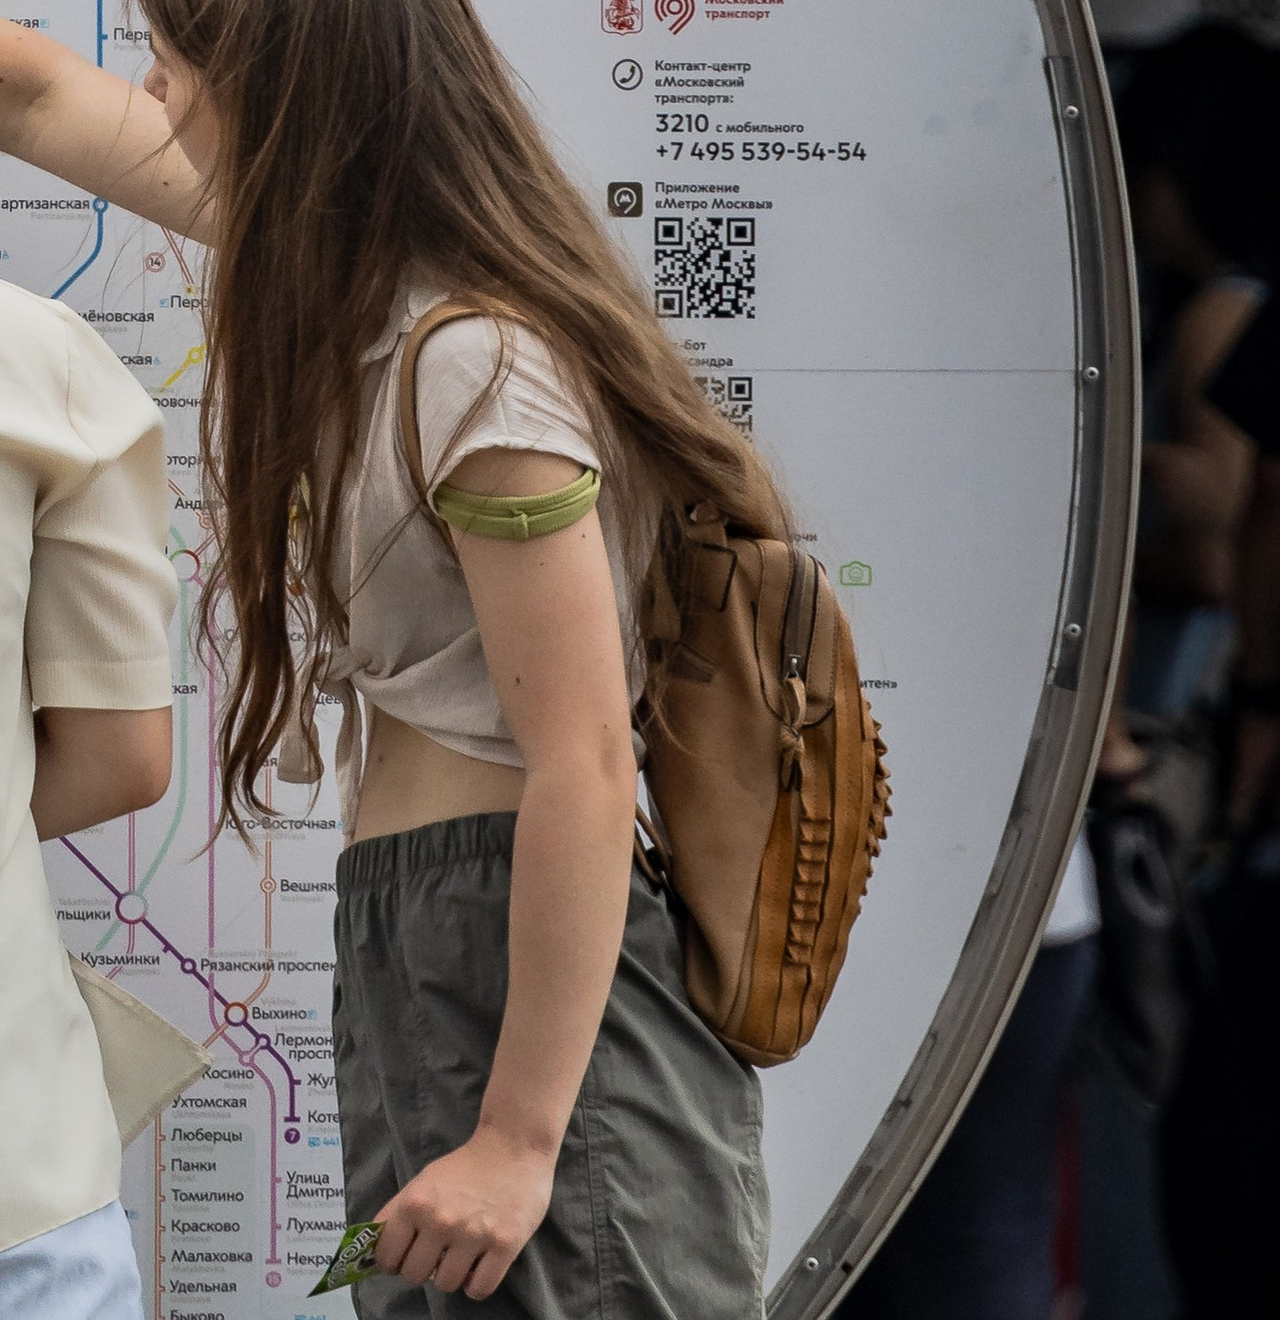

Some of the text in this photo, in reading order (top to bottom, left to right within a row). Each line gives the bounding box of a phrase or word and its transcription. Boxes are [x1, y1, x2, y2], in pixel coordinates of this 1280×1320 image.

[704, 9, 770, 20] транспорт
[654, 59, 752, 74] Контакт-центр
[654, 76, 745, 88] «Московский
[654, 93, 734, 106] транспорт»:
[655, 113, 804, 134] 3210 с мобильного
[656, 141, 867, 161] +7 495 539-54-54
[654, 181, 740, 195] Приложение
[654, 198, 773, 211] «Метро Москвы»
[81, 953, 160, 968] Кузьминки
[252, 1007, 307, 1021] Выхино
[170, 1129, 242, 1144] Люберцы
[171, 1189, 244, 1204] Томилино
[171, 1250, 253, 1264] Малаховка
